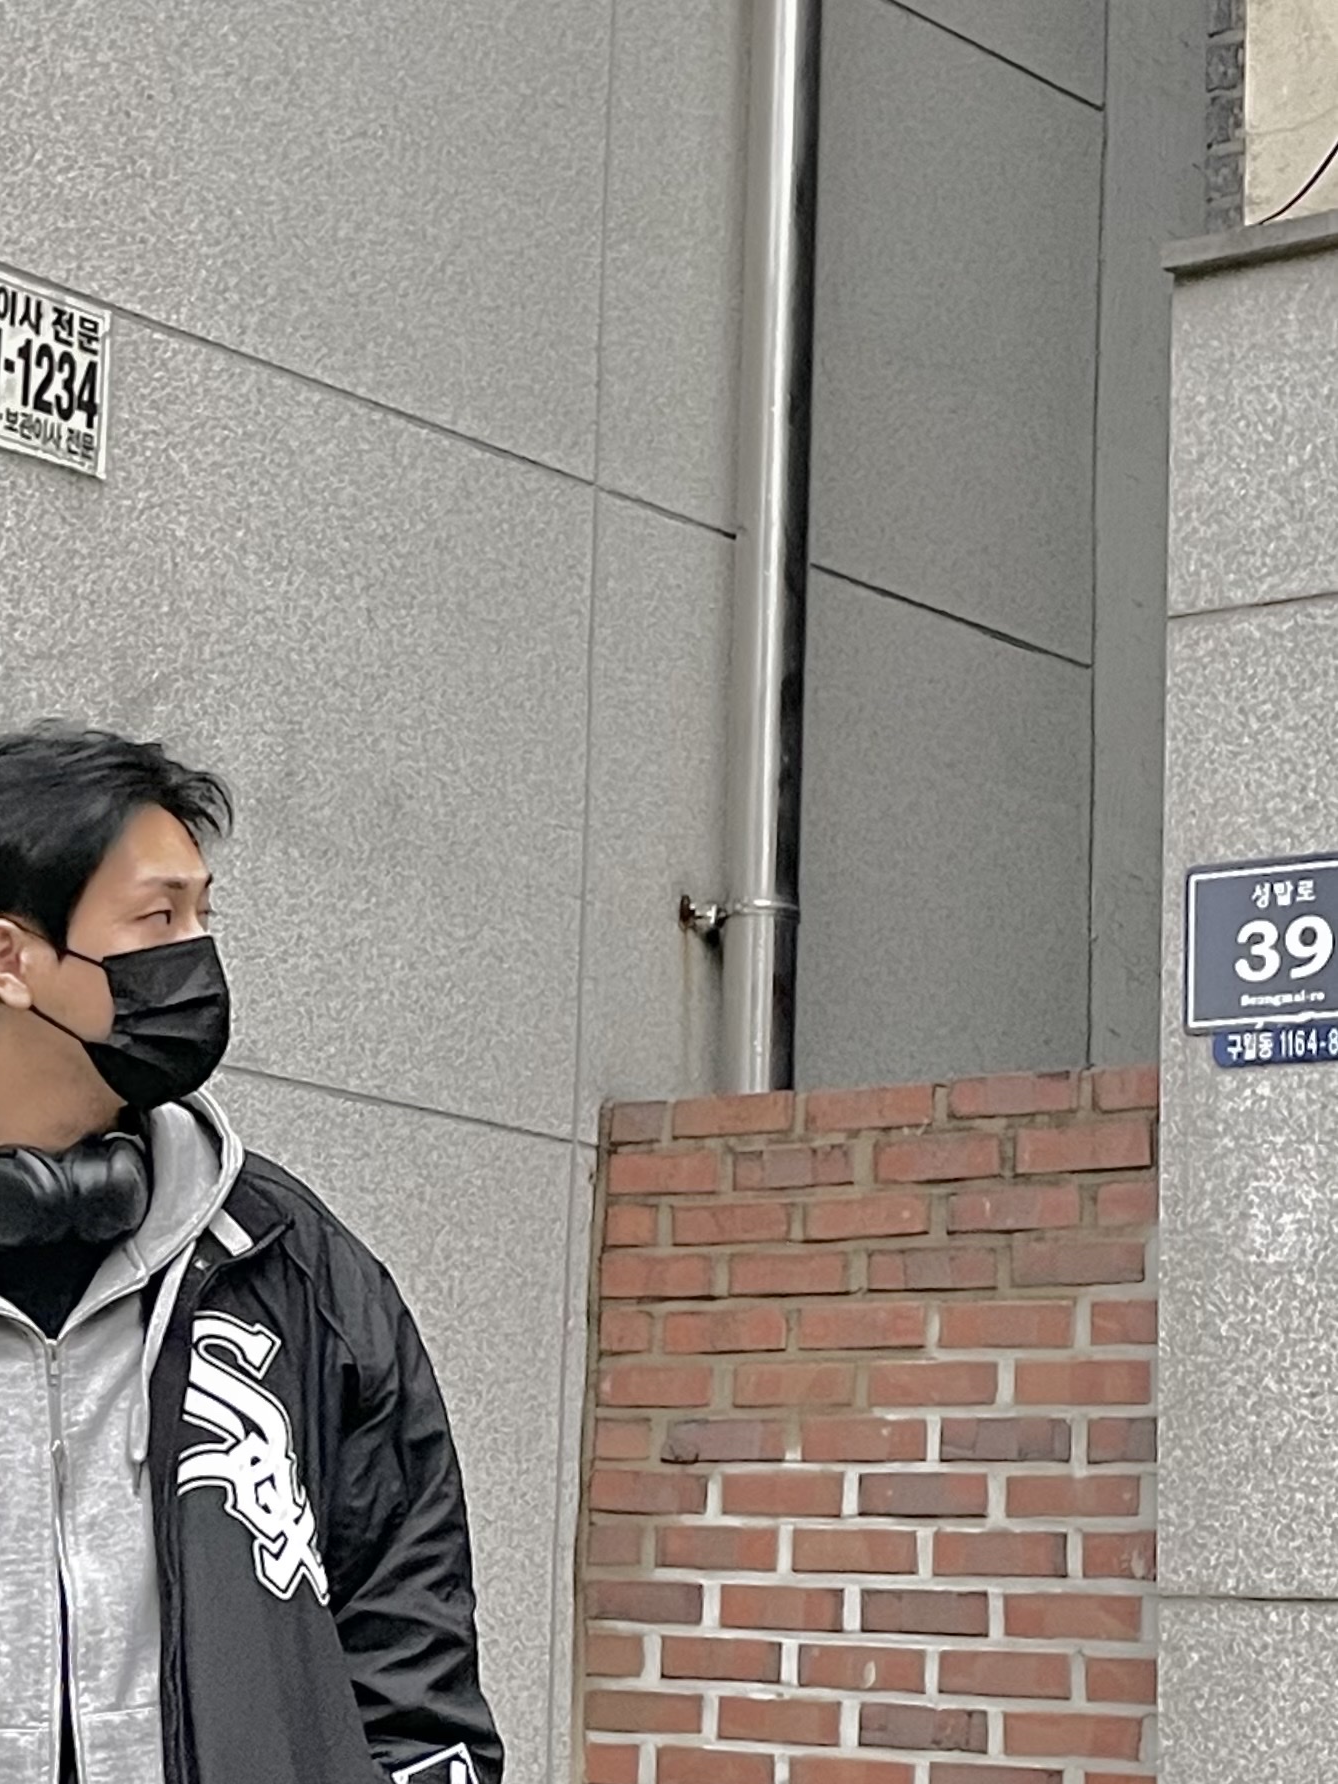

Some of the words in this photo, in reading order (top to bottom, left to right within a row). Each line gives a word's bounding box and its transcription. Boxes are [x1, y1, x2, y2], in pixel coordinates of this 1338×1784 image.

[52, 306, 99, 356] 전문
[66, 428, 95, 461] 전문
[1234, 915, 1334, 982] 39
